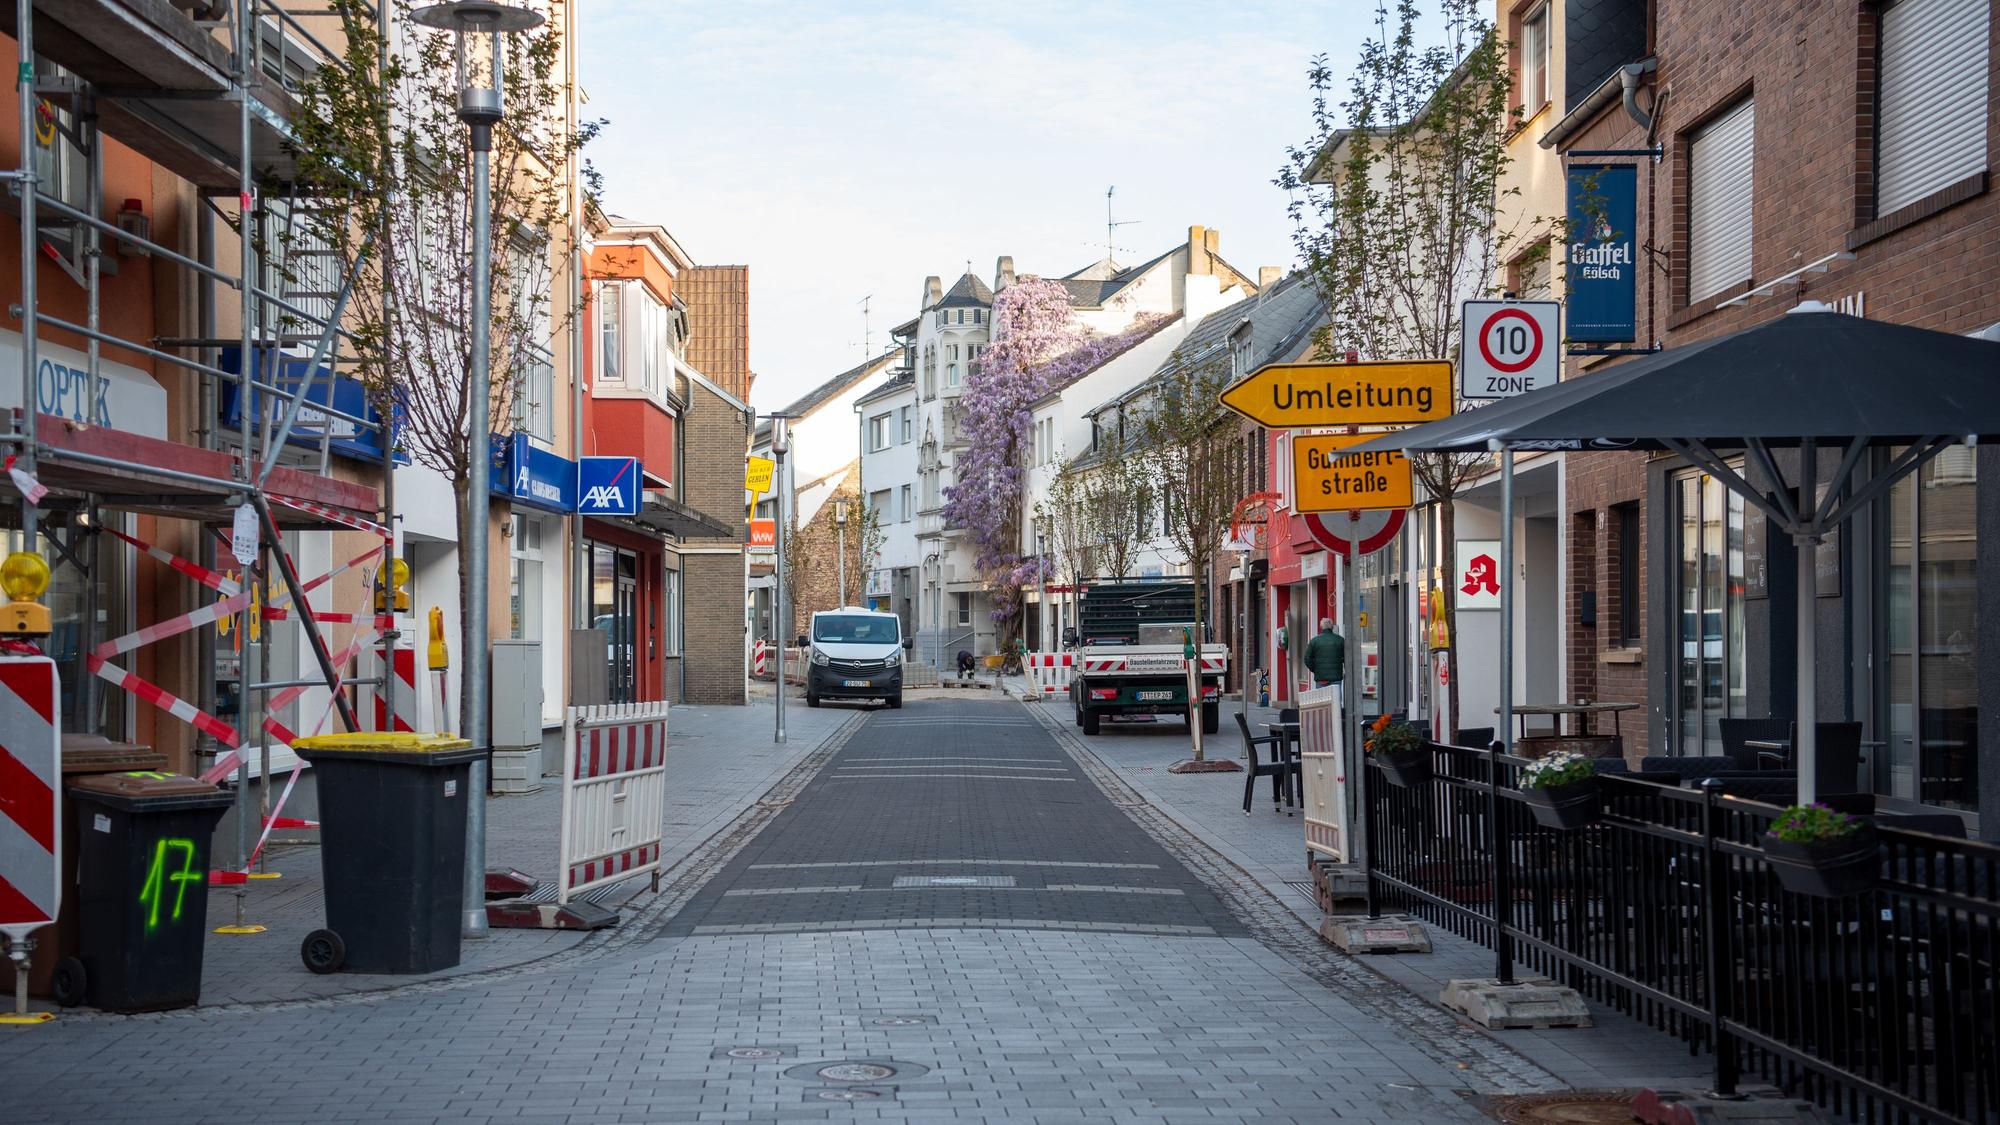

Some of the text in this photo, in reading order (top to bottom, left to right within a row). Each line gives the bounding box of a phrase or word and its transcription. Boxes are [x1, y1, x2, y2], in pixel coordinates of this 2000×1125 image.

[1571, 242, 1632, 266] Gaffel
[1583, 265, 1620, 280] Kölsch
[1496, 326, 1526, 355] 10
[38, 359, 112, 430] OPTK
[1486, 377, 1535, 392] ZONE
[1273, 382, 1432, 413] Umleitung
[1321, 470, 1388, 495] straße
[578, 486, 625, 508] AXA
[1129, 658, 1179, 667] Baustellenfahrzeug
[140, 838, 203, 927] 17
